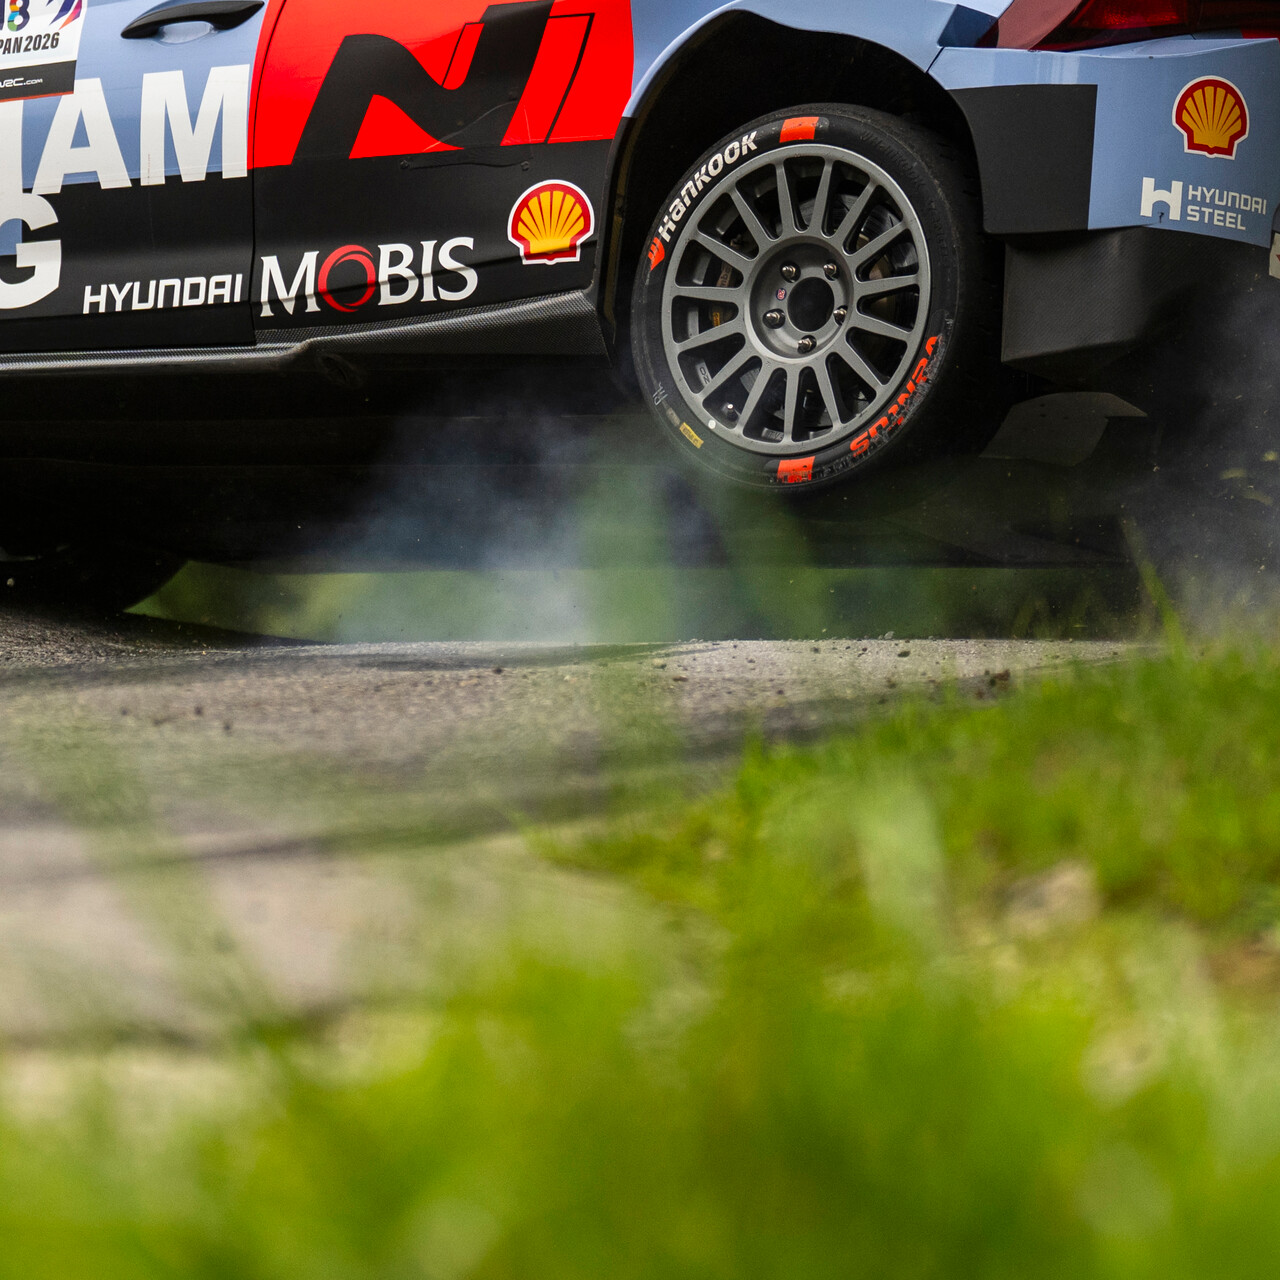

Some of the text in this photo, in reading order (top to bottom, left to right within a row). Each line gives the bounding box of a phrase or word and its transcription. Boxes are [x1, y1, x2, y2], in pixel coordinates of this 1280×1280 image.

[23, 32, 60, 52] 2026
[1188, 184, 1267, 215] HYUNDAI
[1186, 205, 1246, 230] STEEL
[82, 237, 478, 317] HYUNDAI MOBIS
